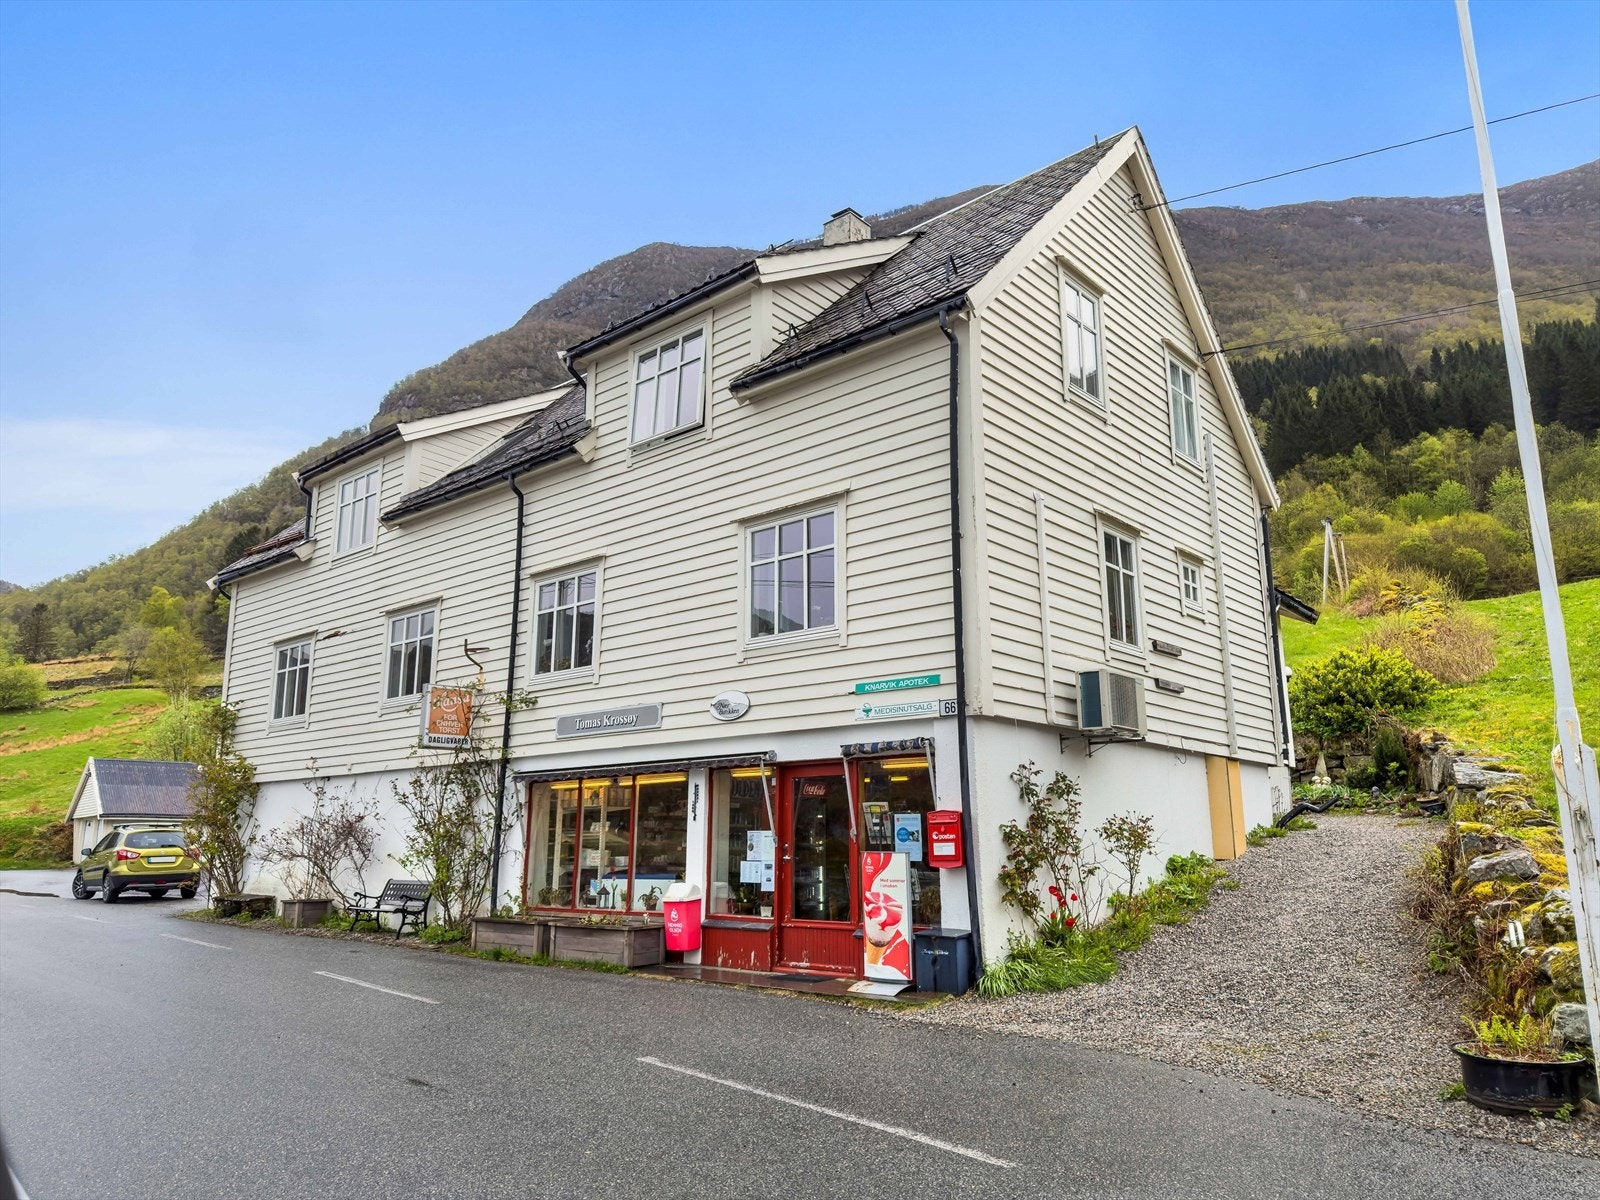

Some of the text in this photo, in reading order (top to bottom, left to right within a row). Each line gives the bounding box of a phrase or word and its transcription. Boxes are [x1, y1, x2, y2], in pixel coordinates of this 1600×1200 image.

[864, 678, 929, 691] KNARVIK APOTEK
[874, 703, 933, 715] MEDISINUTSALG
[944, 701, 956, 714] 66
[575, 713, 639, 730] Tomas Krossøy
[938, 833, 956, 841] posten
